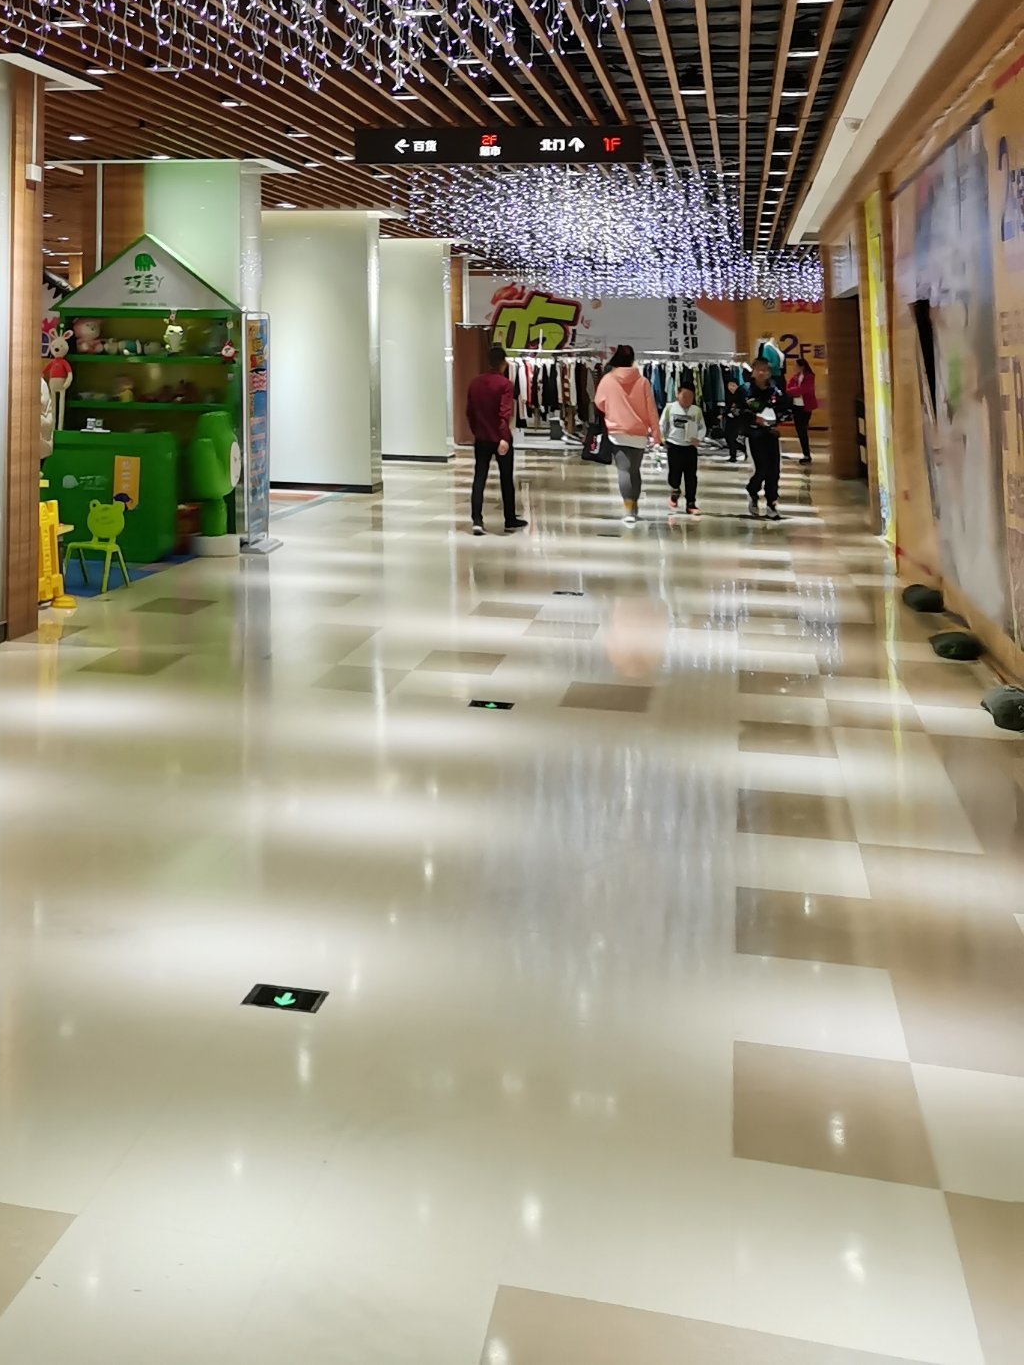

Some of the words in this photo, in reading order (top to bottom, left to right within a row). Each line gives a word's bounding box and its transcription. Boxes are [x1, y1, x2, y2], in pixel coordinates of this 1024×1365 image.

[412, 139, 437, 152] 百货
[481, 134, 497, 145] 2F
[539, 138, 566, 151] 北门
[603, 137, 622, 152] 1F
